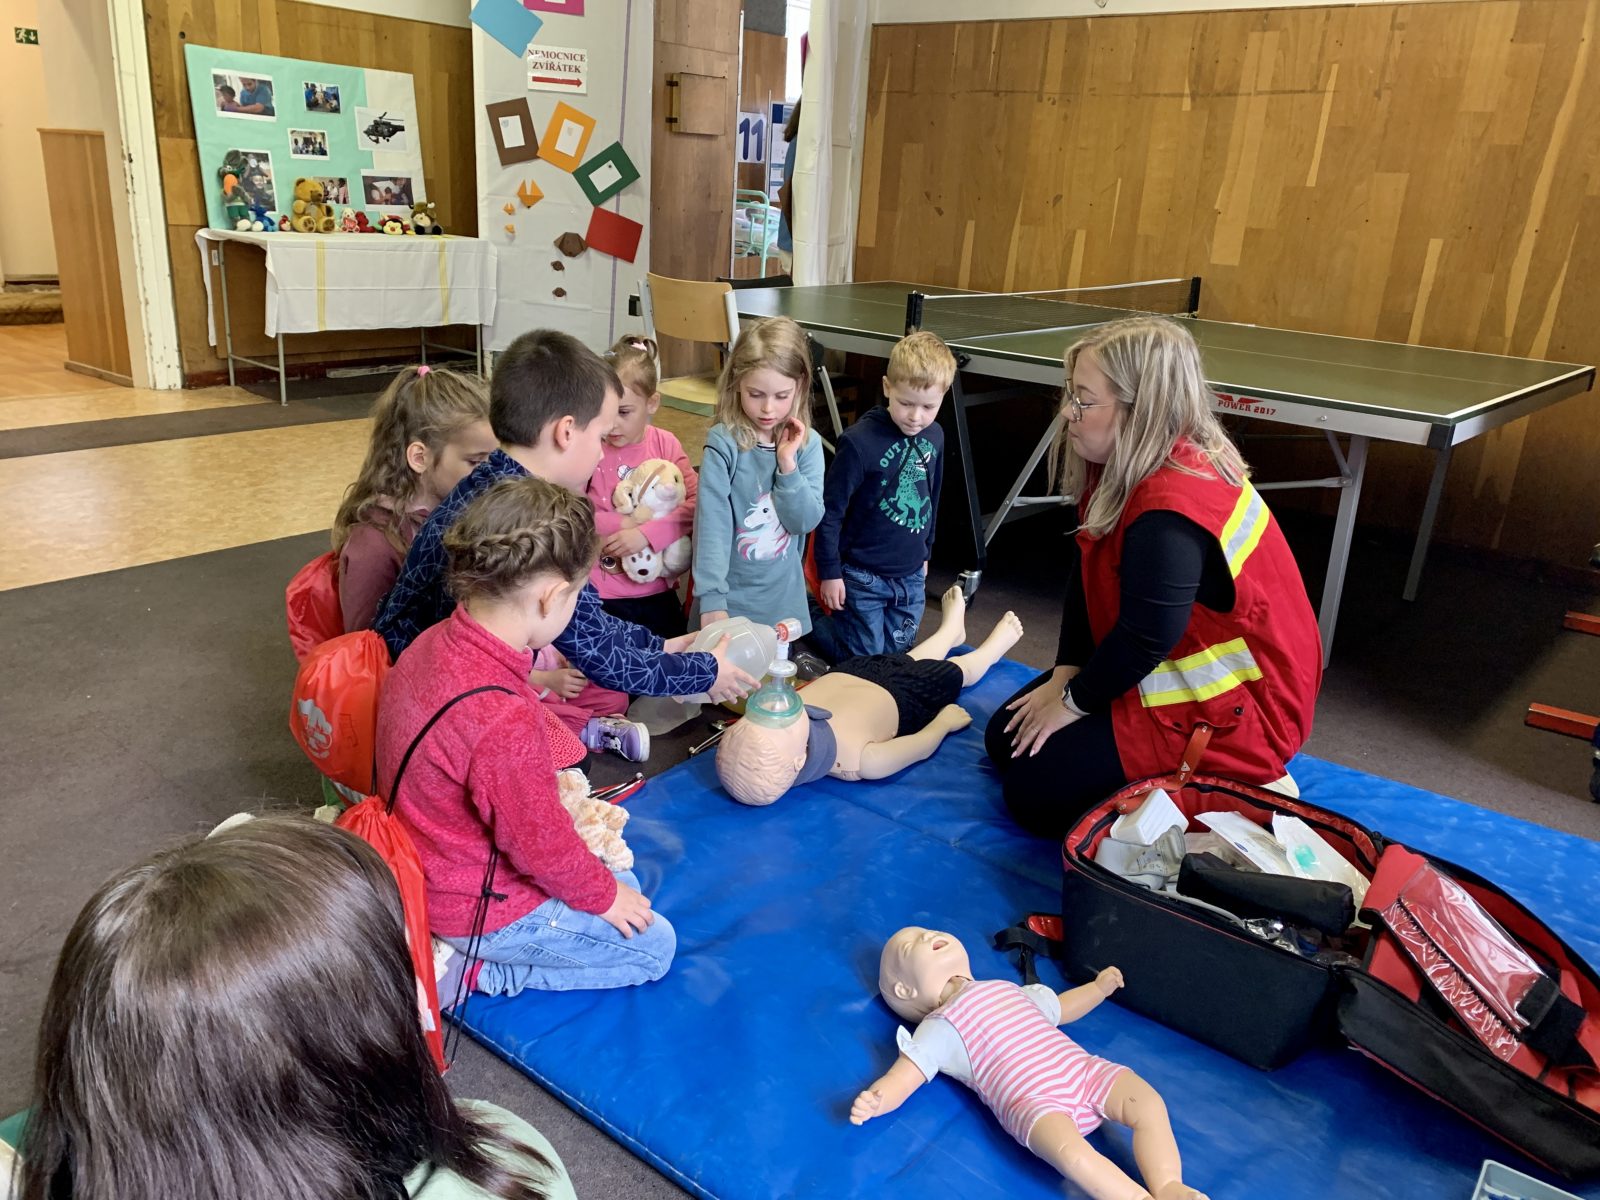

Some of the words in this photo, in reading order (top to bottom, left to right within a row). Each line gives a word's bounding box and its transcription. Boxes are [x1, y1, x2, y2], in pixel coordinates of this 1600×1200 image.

[532, 60, 581, 73] ZVÍŘÁTEK
[739, 118, 764, 161] 11
[1218, 400, 1251, 412] POWER
[1254, 406, 1276, 415] 2017
[880, 442, 901, 468] OUT
